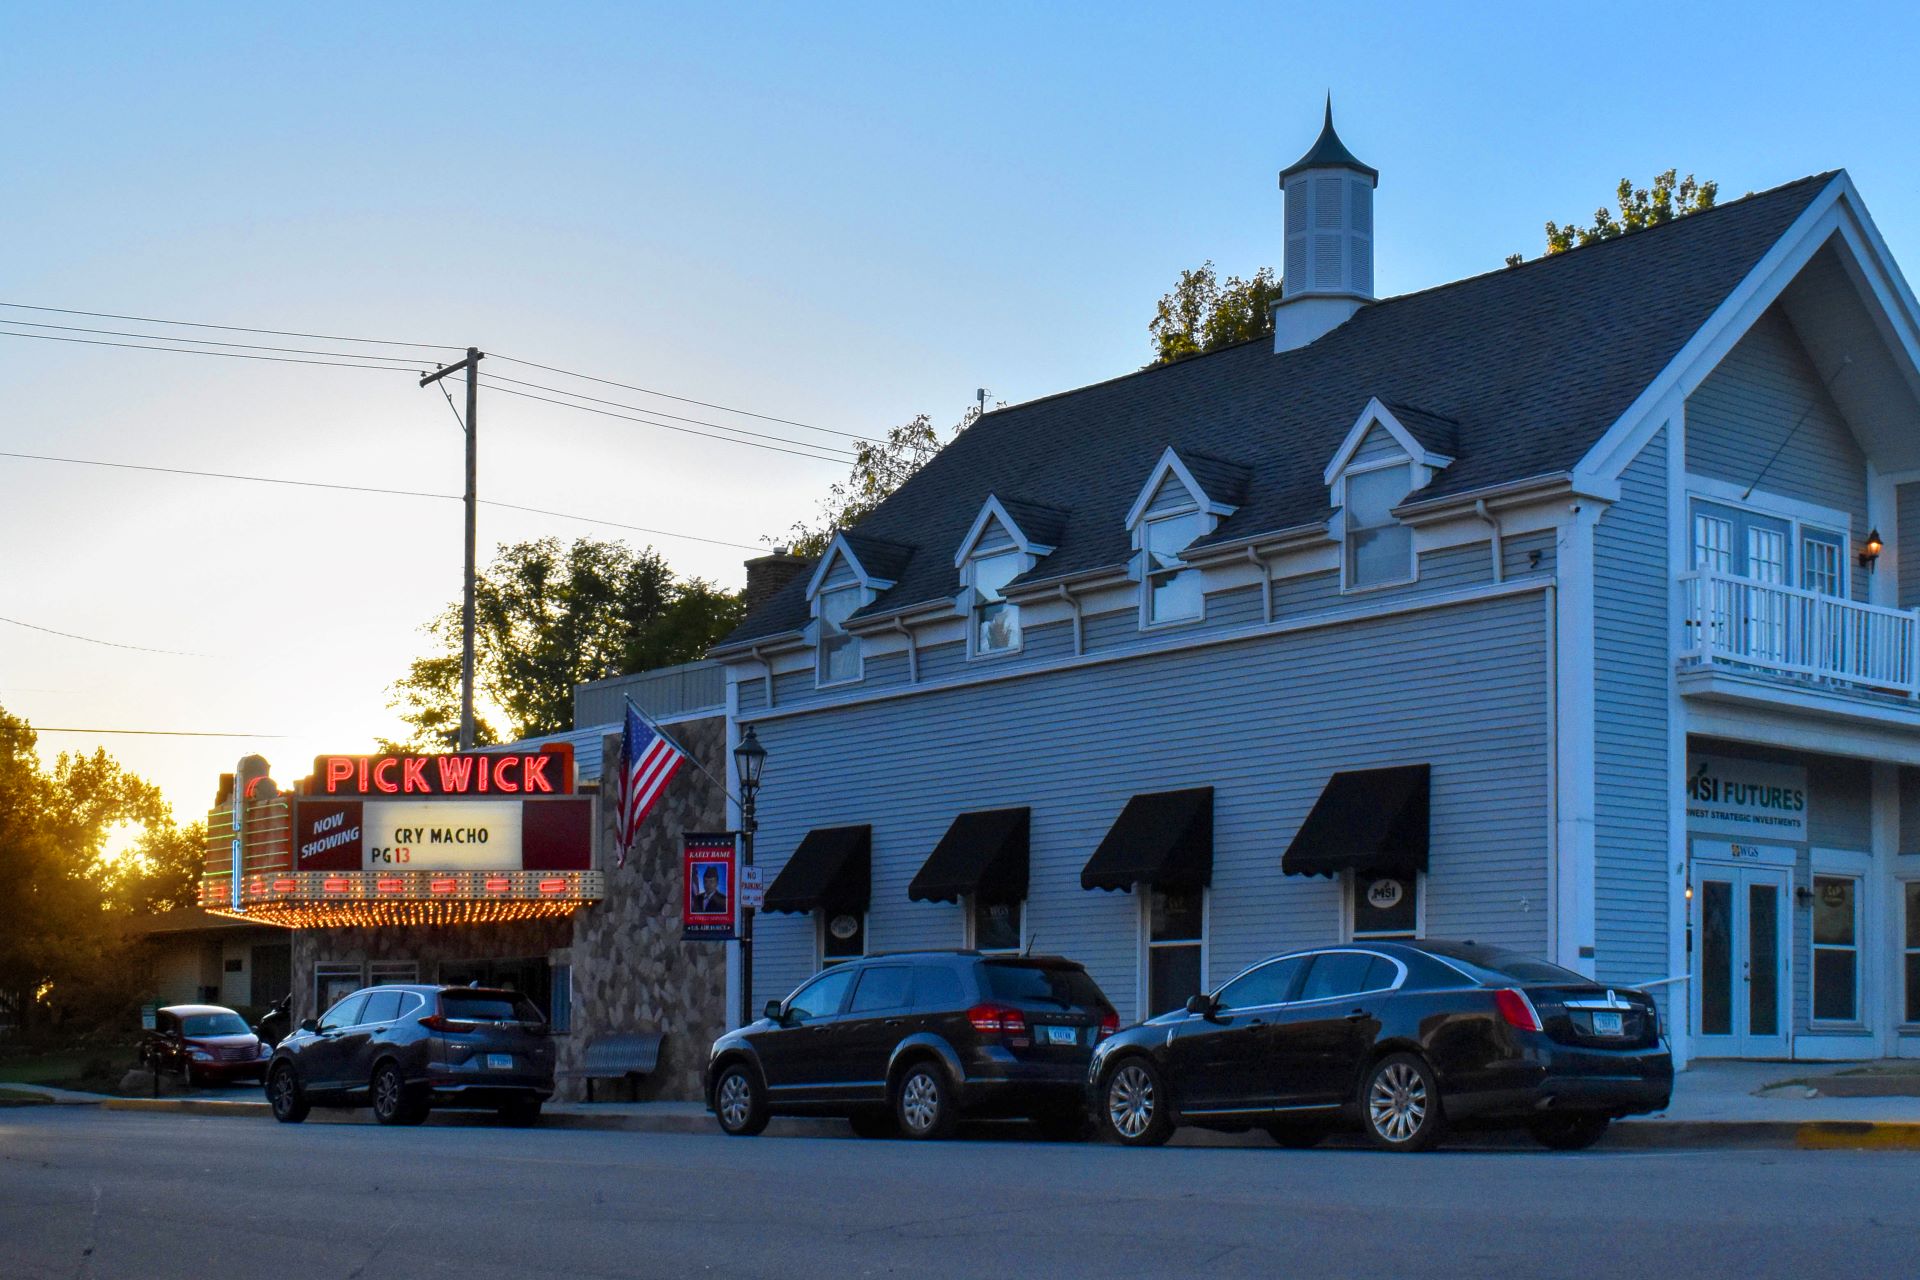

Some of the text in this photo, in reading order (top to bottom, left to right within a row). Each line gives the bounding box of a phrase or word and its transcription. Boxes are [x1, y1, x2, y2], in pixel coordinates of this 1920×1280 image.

[326, 756, 554, 793] PICKWICK
[1723, 781, 1804, 811] FUTURES
[313, 812, 344, 834] NOW
[1711, 810, 1751, 822] STRATEGIC
[1752, 815, 1800, 827] INVESTMENTS
[301, 826, 359, 858] SHOWING
[395, 828, 489, 844] CRY MACHO
[1740, 846, 1759, 857] WGS
[747, 871, 757, 880] NO
[1371, 887, 1395, 898] MSI
